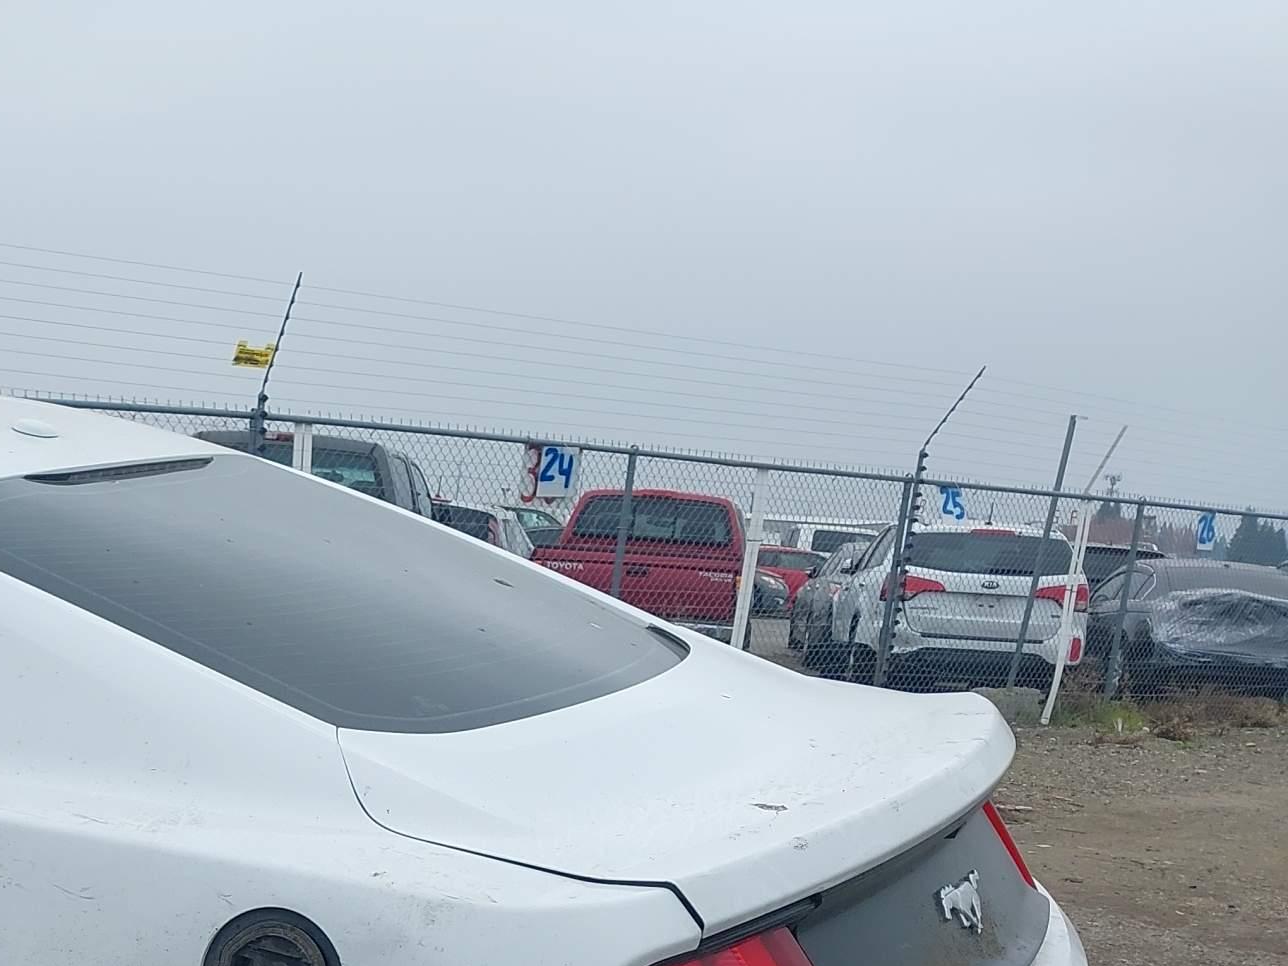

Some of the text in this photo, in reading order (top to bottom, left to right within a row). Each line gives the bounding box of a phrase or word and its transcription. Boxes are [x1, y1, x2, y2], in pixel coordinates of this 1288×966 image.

[540, 448, 573, 488] 24
[940, 486, 965, 520] 25
[546, 561, 584, 571] TOYOTA
